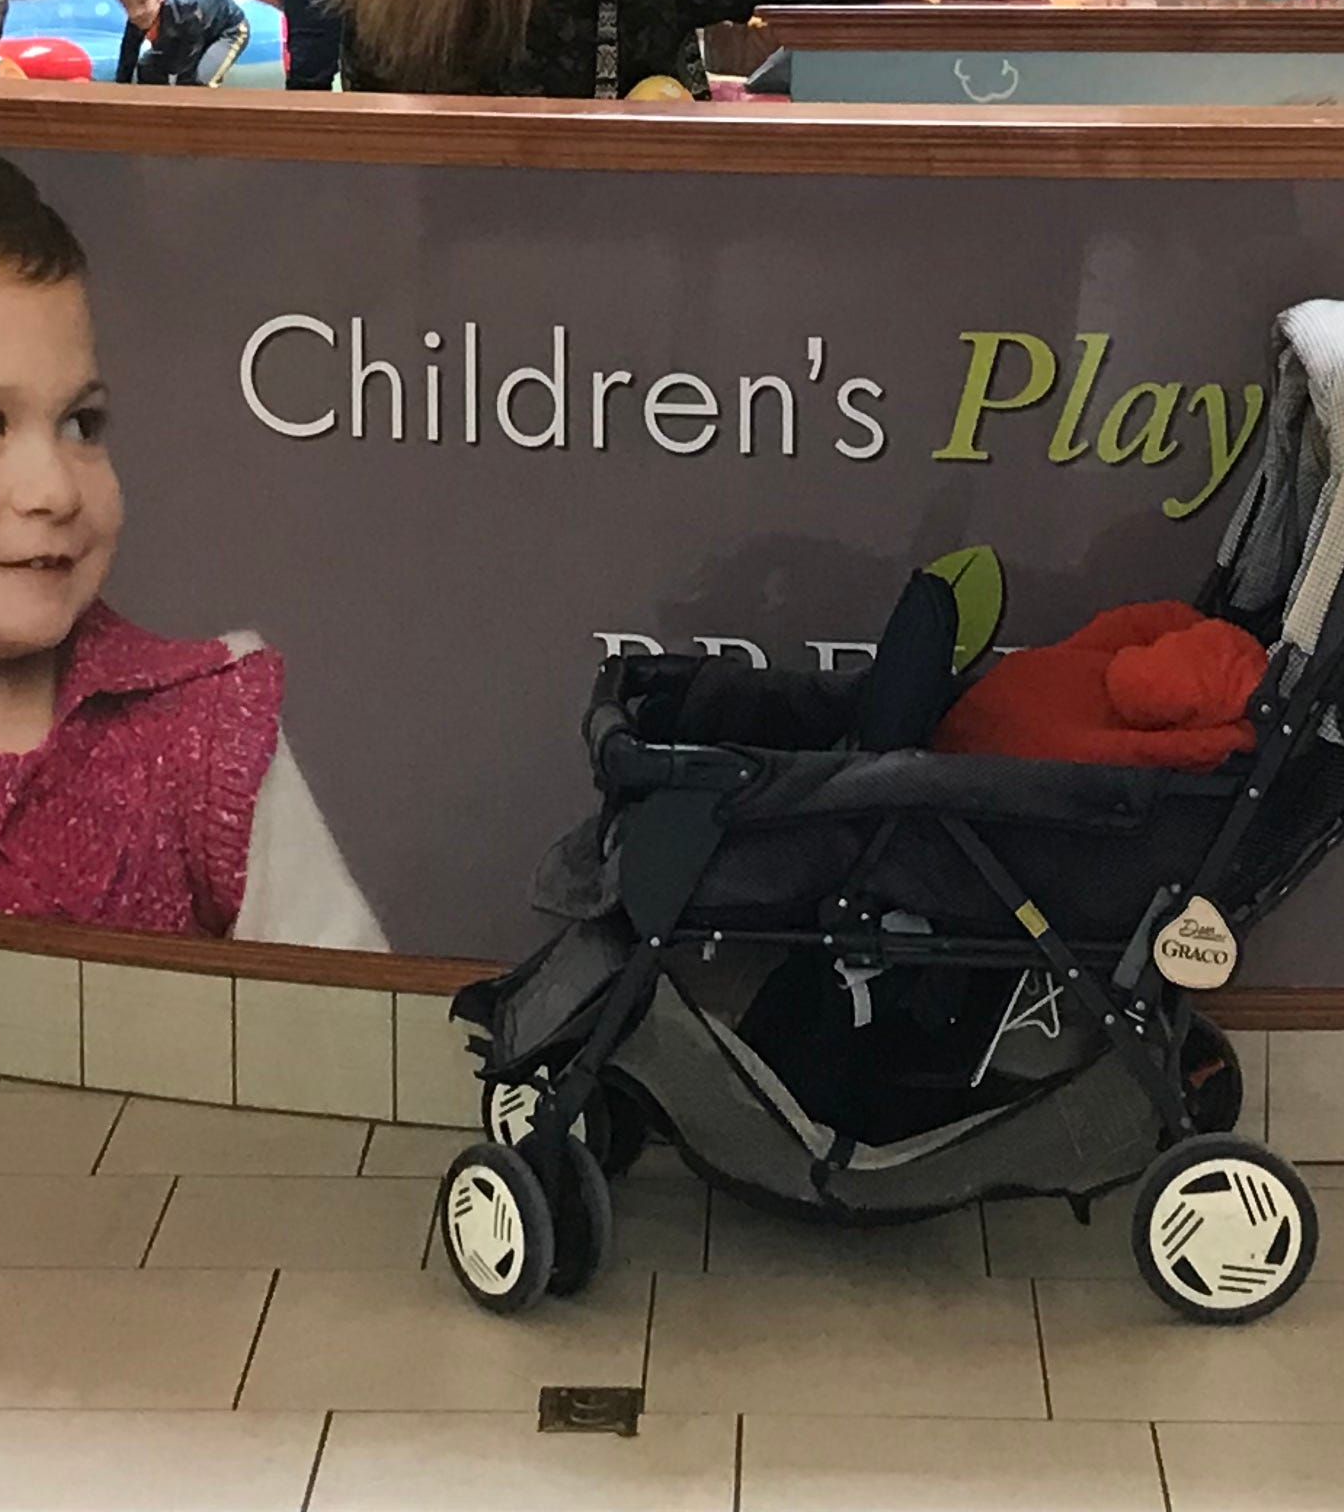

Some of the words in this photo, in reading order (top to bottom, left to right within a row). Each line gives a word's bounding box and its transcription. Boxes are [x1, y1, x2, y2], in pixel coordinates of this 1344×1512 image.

[240, 313, 885, 459] Children's
[932, 330, 1264, 519] Play
[1162, 939, 1228, 965] GRACO
